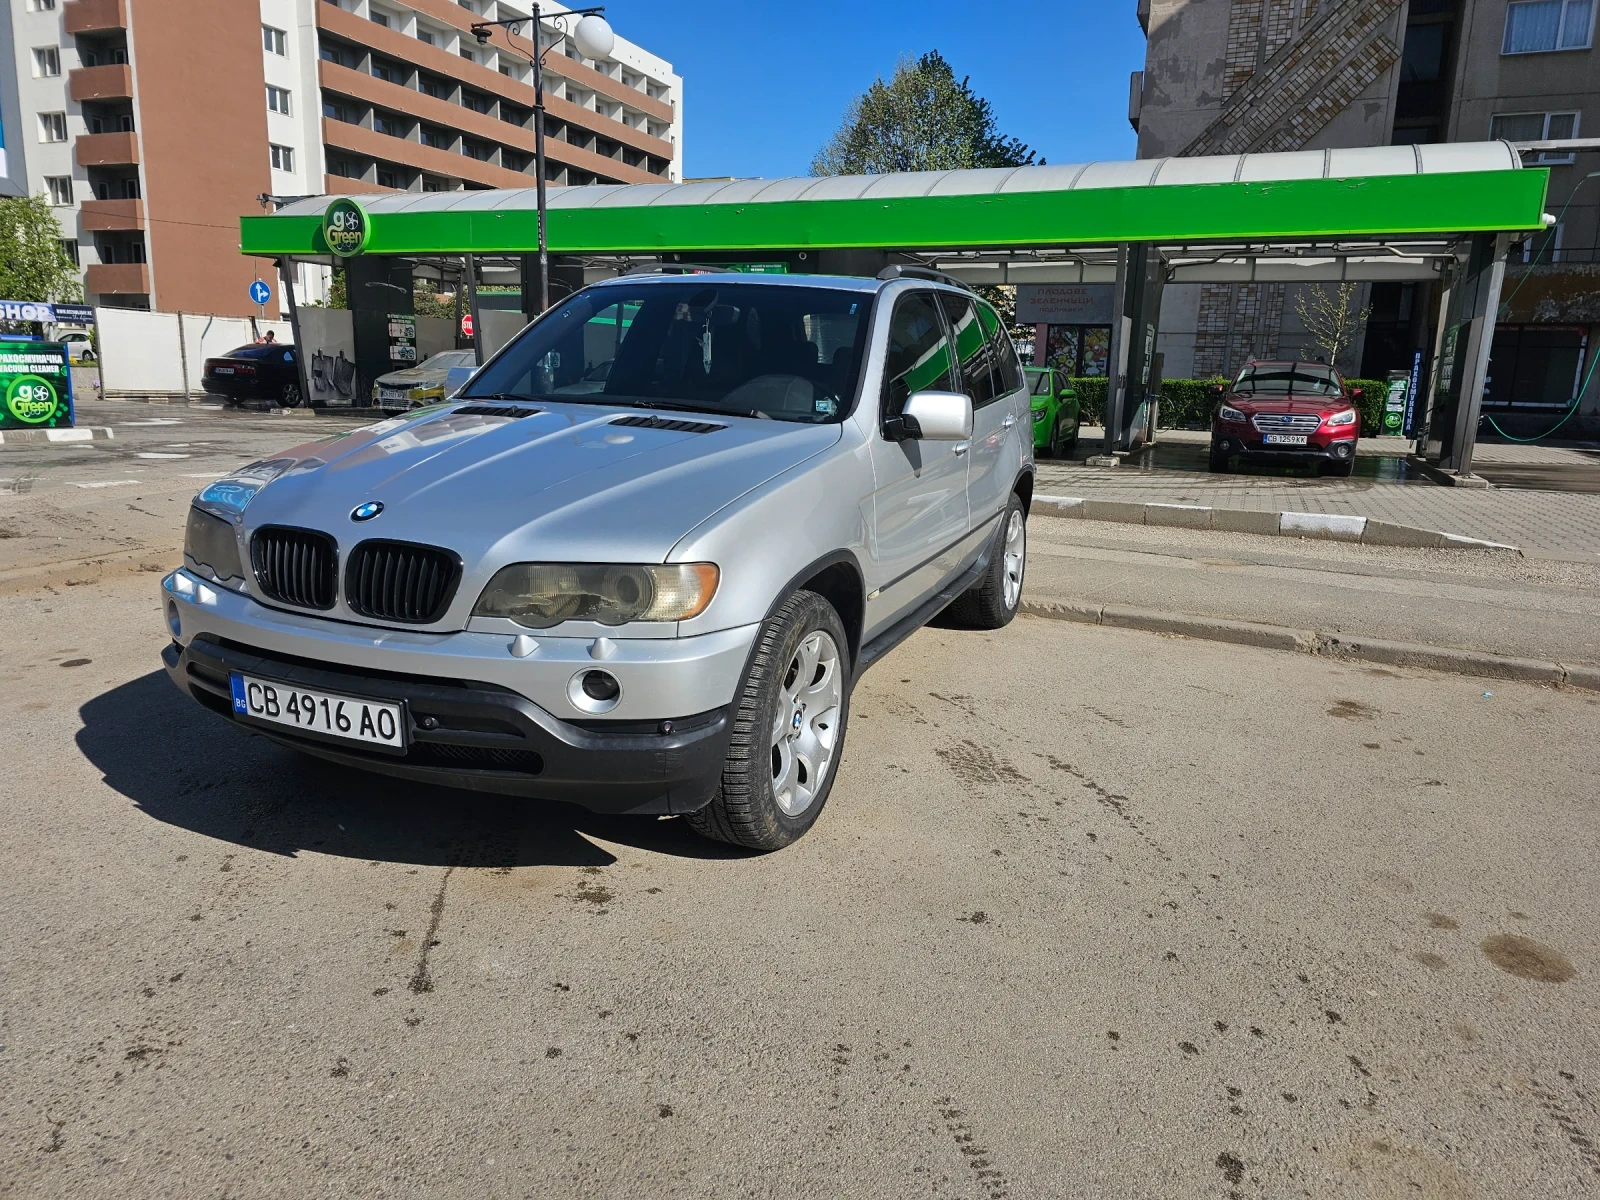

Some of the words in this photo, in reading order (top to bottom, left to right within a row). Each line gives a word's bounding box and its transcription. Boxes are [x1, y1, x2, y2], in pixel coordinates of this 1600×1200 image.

[334, 210, 359, 231] go
[327, 225, 362, 245] Green
[1037, 288, 1088, 296] ПЛОДОВЕ
[1030, 297, 1094, 305] ЗЕЛЕНЧУЦИ
[463, 321, 473, 329] STO
[30, 364, 60, 373] CLEANER
[19, 385, 49, 402] go
[11, 397, 53, 413] Green
[236, 698, 247, 709] BG
[247, 683, 281, 717] CB
[286, 692, 352, 733] 4916
[360, 705, 396, 741] AO
